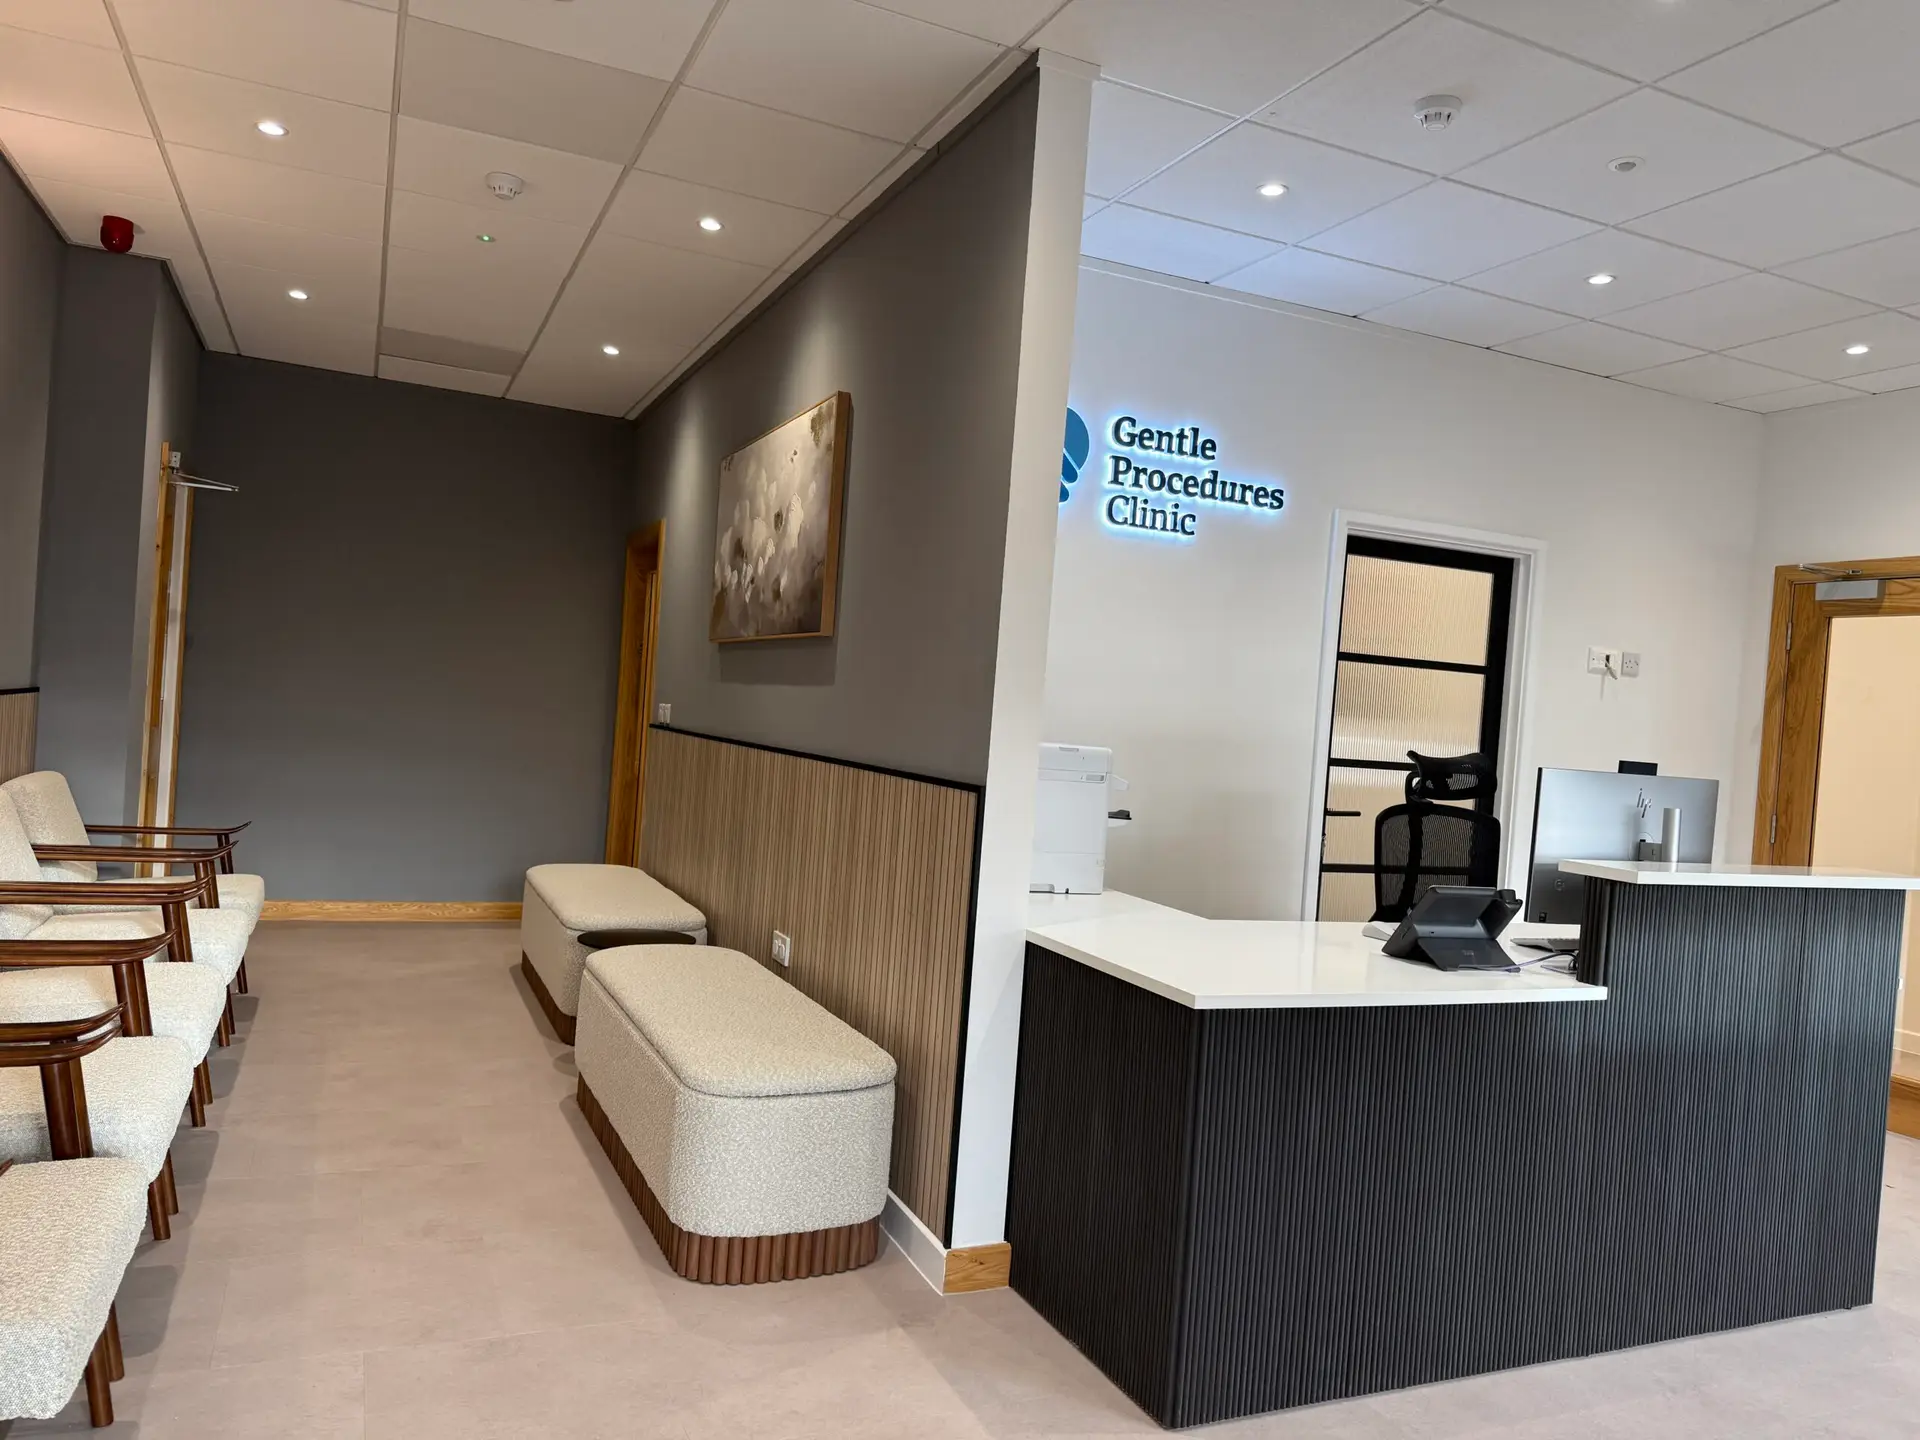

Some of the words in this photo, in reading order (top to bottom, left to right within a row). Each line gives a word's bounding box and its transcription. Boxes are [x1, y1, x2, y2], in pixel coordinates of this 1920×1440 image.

[1112, 416, 1217, 461] Gentle
[1107, 455, 1285, 510] Procedures
[1106, 494, 1197, 536] Clinic
